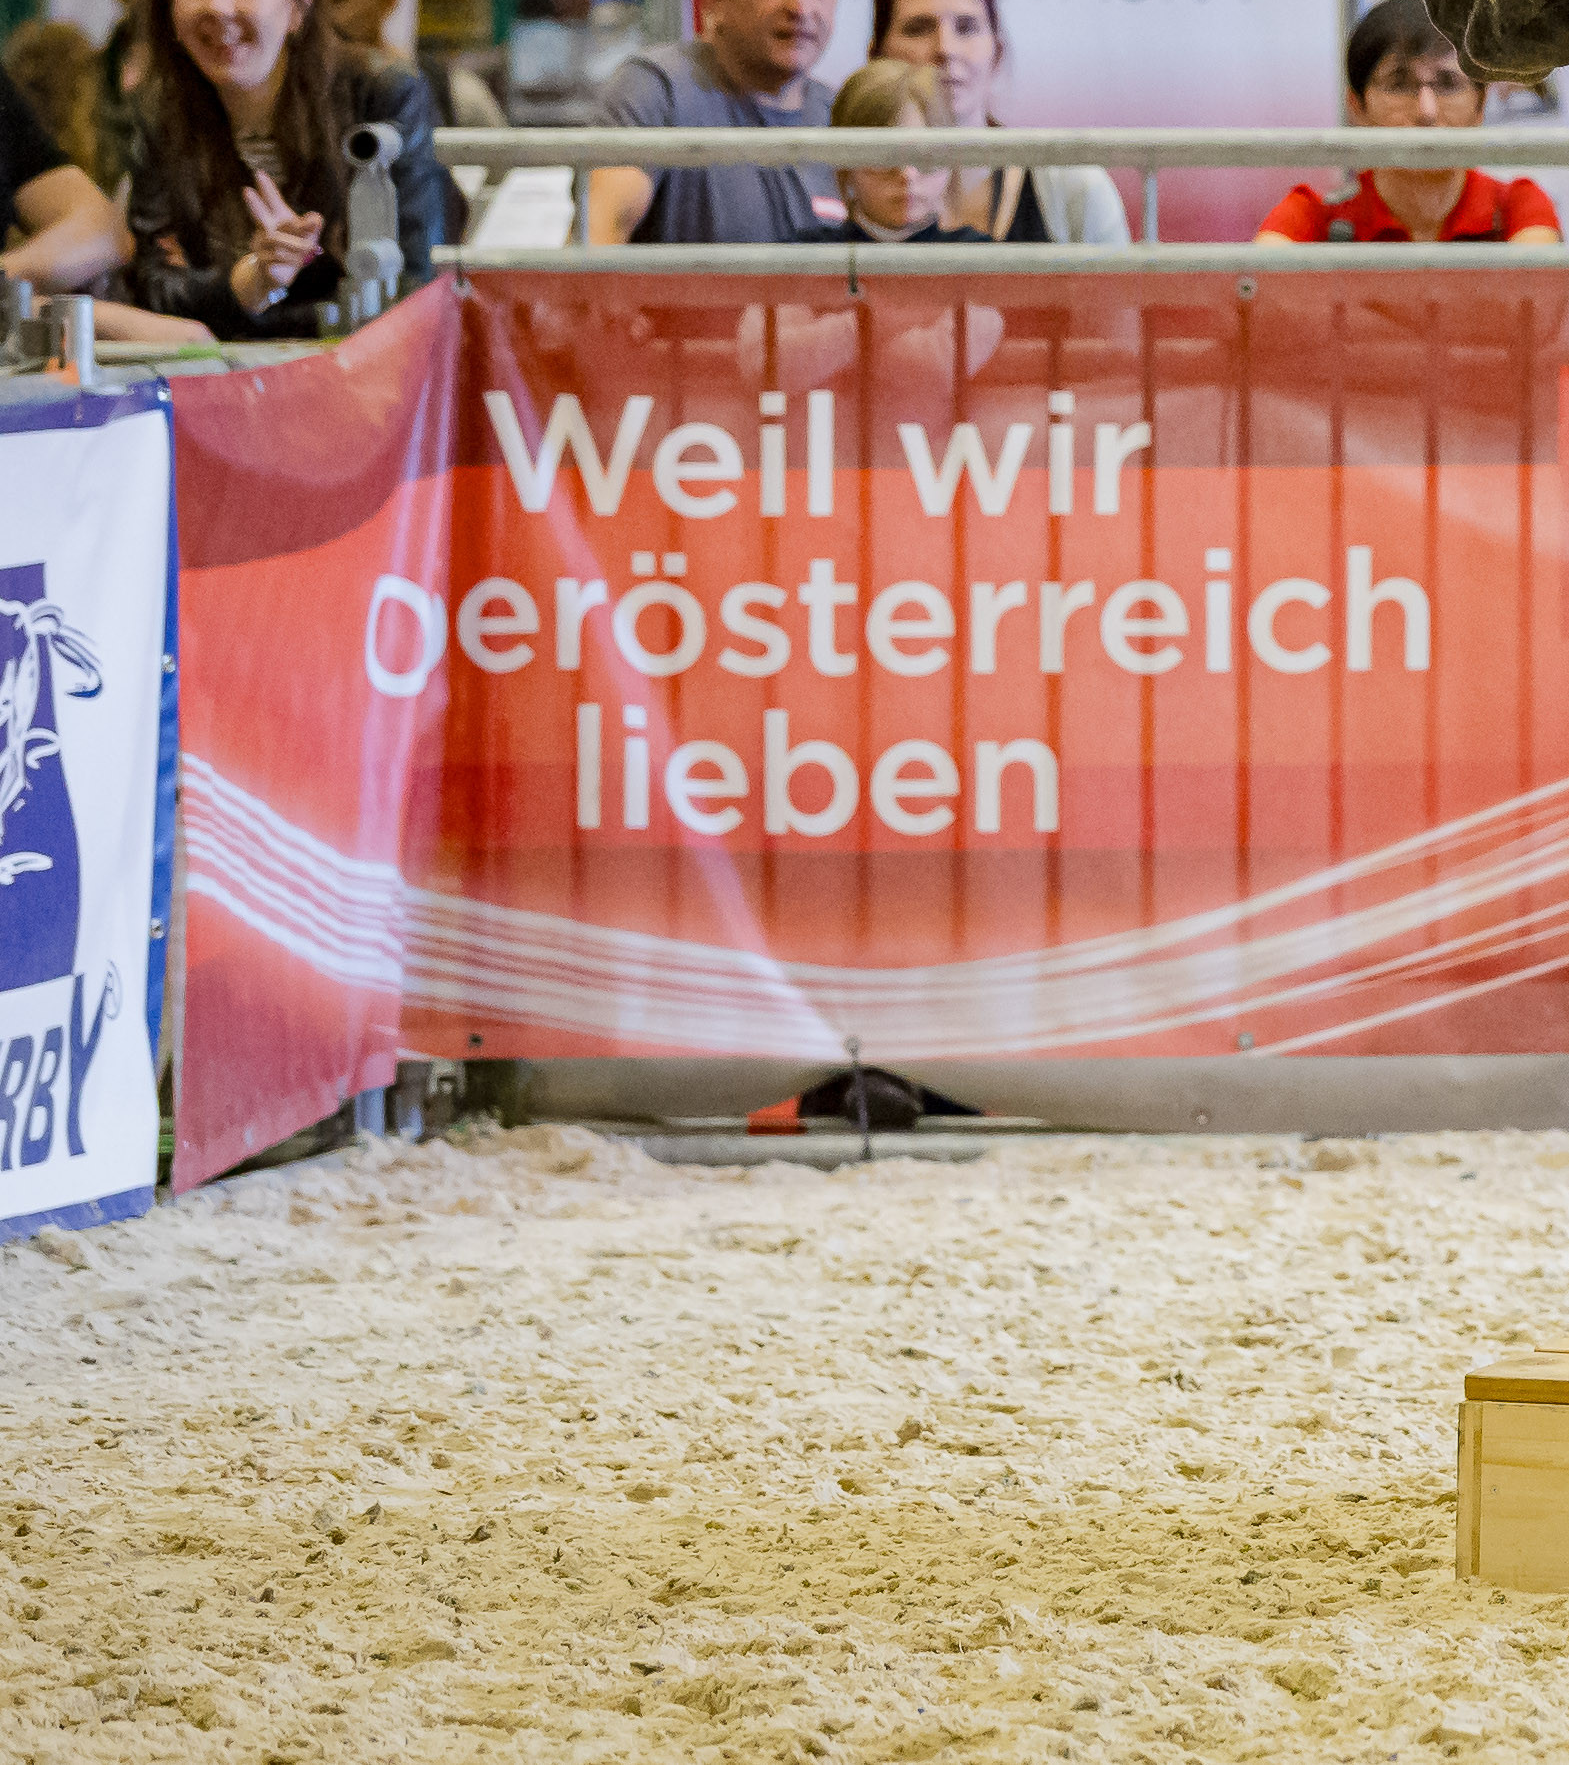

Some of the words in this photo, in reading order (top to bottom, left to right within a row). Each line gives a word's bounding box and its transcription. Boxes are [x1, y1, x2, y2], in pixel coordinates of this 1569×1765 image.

[485, 391, 835, 519] Weil
[898, 391, 1150, 518] wir
[364, 545, 1431, 698] Oerösterreich
[577, 703, 1058, 836] lieben
[0, 972, 108, 1172] RBY
